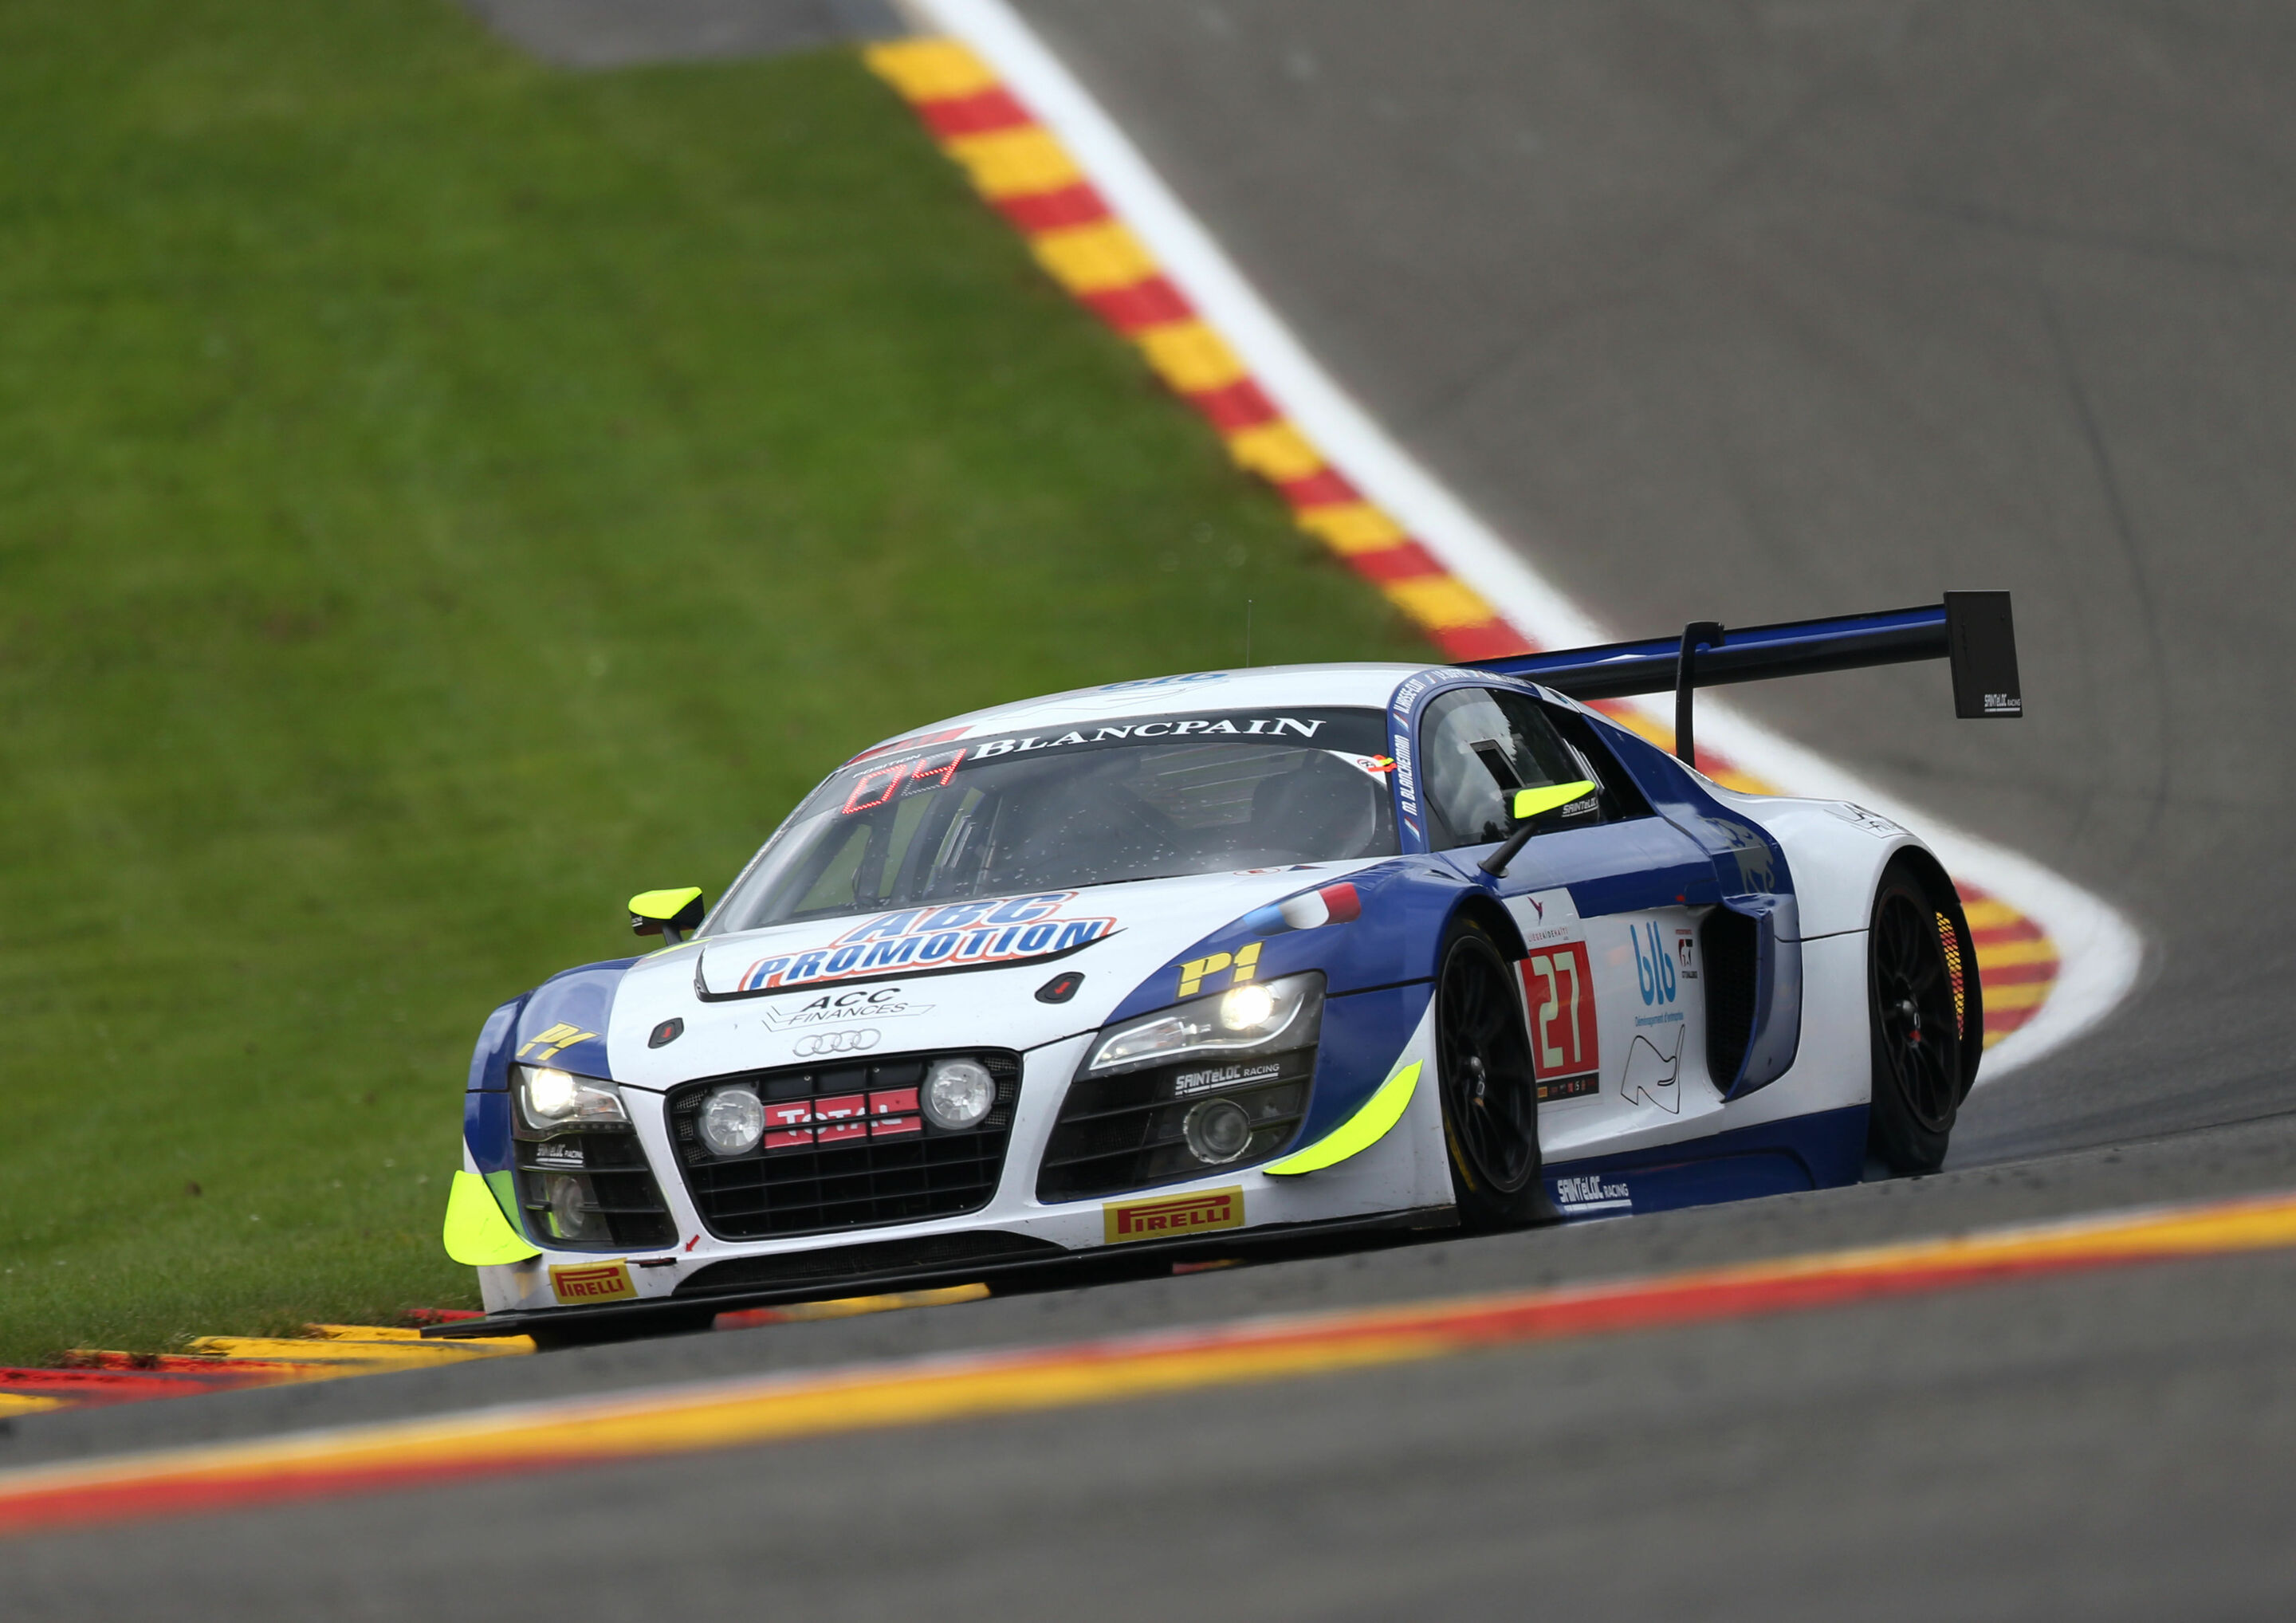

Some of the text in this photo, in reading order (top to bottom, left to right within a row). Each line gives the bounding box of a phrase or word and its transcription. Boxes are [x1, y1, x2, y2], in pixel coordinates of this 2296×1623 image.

[967, 717, 1327, 760] BLANCPAIN
[852, 753, 922, 779] POSITION
[1394, 734, 1417, 802] BLANCHEMAIN
[842, 892, 1068, 944] ABC
[748, 919, 1108, 992] PROMOTION
[1177, 941, 1265, 998] P1
[788, 1002, 910, 1026] FINANCES
[800, 988, 902, 1011] ACC
[1530, 950, 1582, 1069] 27
[516, 1022, 599, 1062] P1
[1243, 1063, 1280, 1077] RACING
[776, 1104, 902, 1137] TOTAL
[1603, 1183, 1630, 1198] RACING
[1117, 1195, 1231, 1235] PIRELLI
[554, 1266, 626, 1298] PIRELLI
